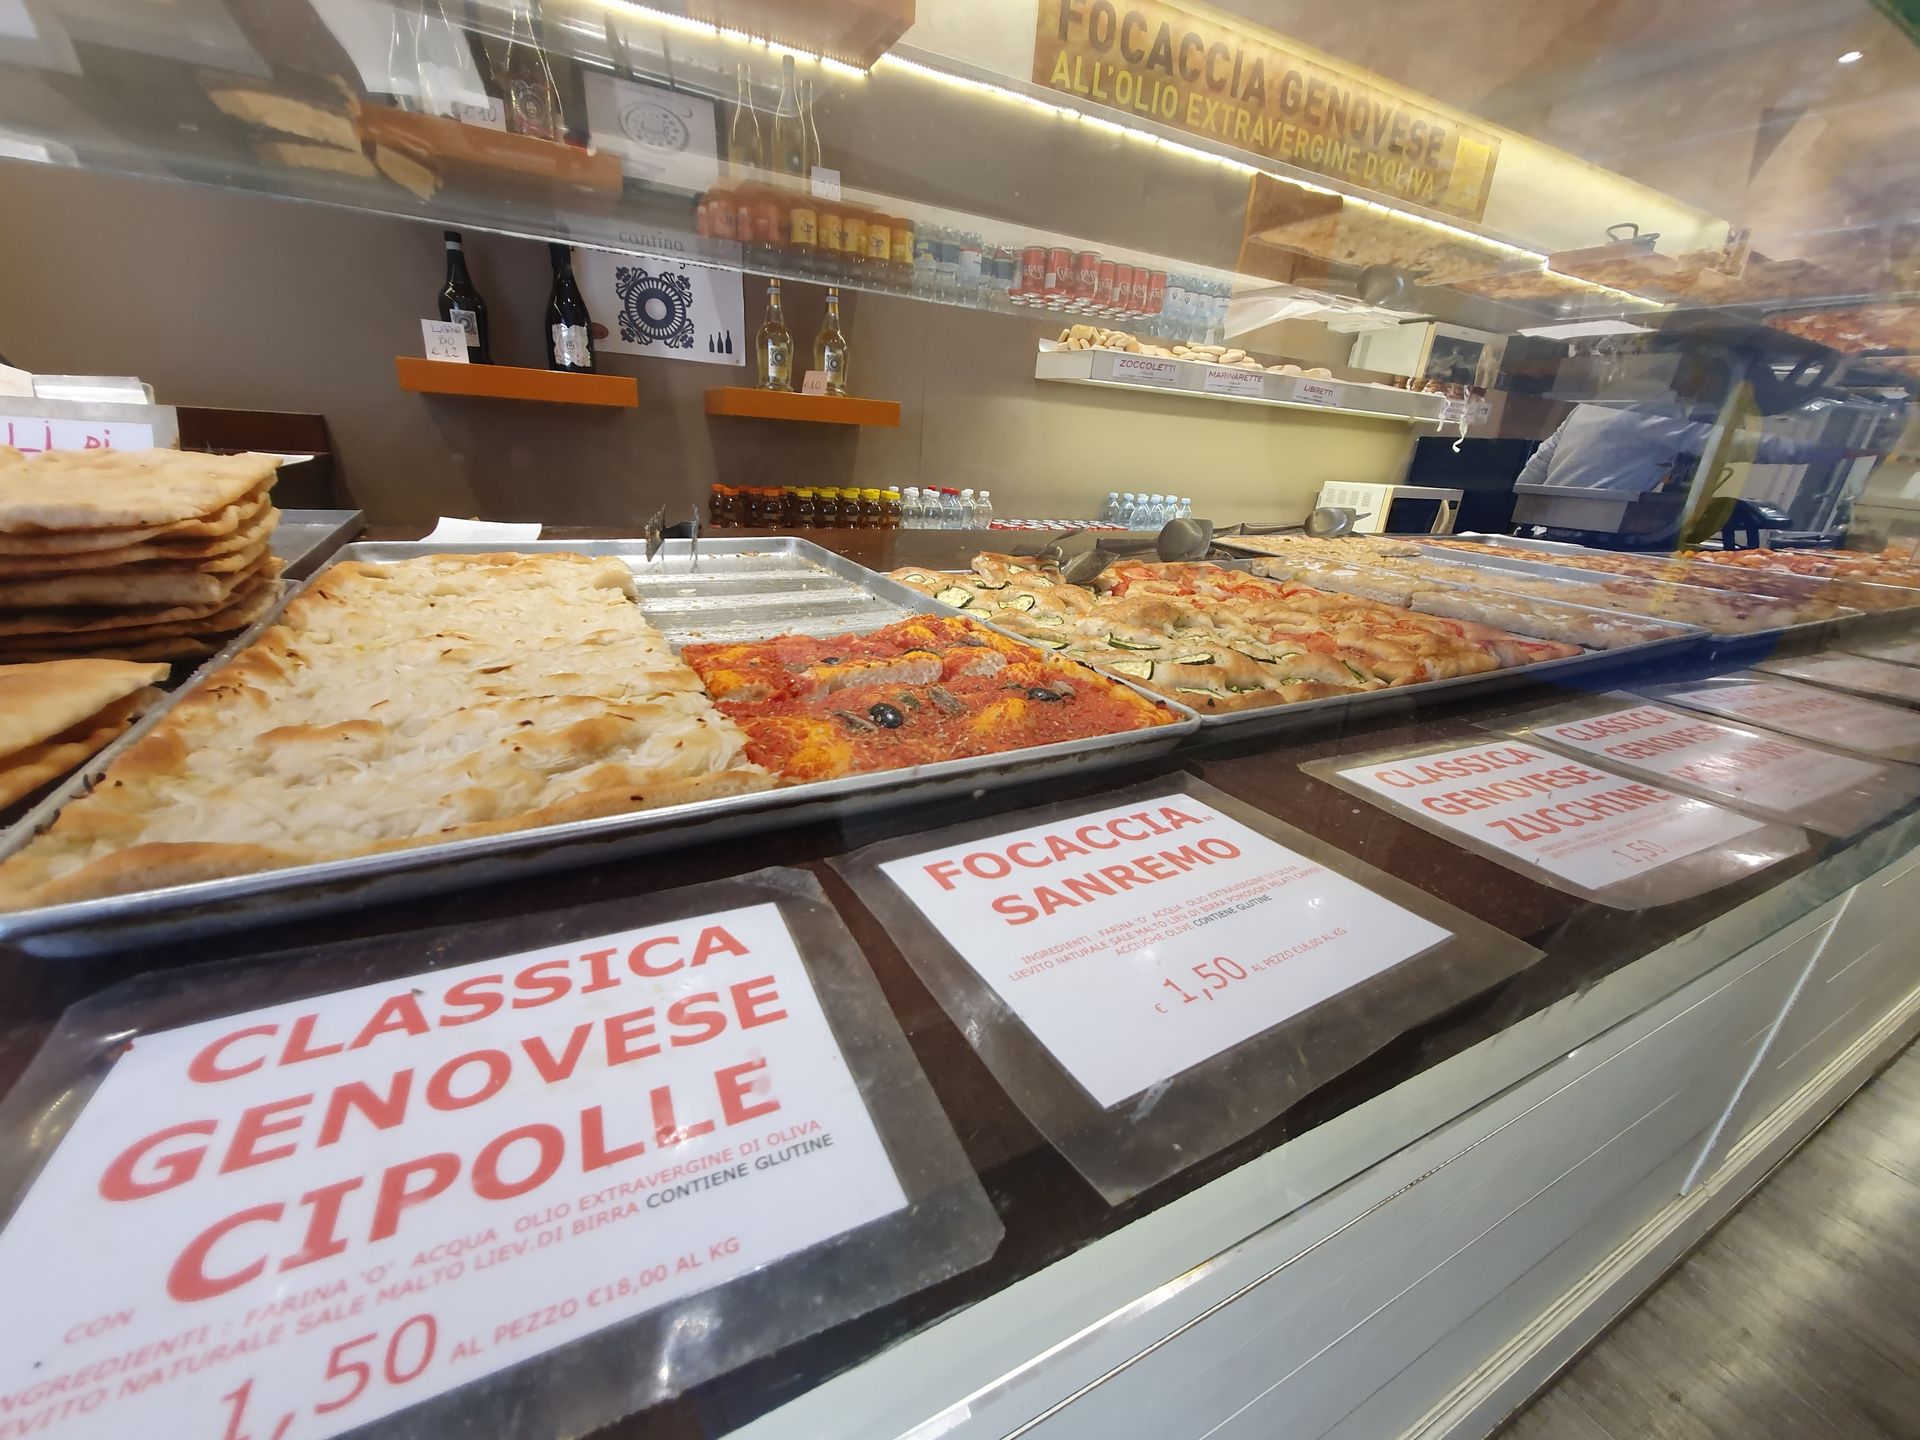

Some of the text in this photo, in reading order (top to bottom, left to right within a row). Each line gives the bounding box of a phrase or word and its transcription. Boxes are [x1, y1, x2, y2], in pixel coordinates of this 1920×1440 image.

[1050, 50, 1435, 198] ALL'OLIO EXTRAVERGINE D'OLIVA
[1058, 0, 1446, 167] FOCACCIA GENOVESE
[618, 231, 685, 252] cantina
[1119, 359, 1177, 372] ZOCCOLETTI
[1208, 371, 1263, 383] MARINARETTE
[1303, 384, 1334, 397] LIBRETTI
[1555, 710, 1677, 741] CLASSICA
[1603, 724, 1726, 760] GENOVESE
[1375, 747, 1543, 789] CLASSICA
[1421, 765, 1605, 817] GENOVESE
[923, 805, 1203, 891] FOCACCIA
[1485, 784, 1674, 842] ZUCCHINE
[1612, 839, 1669, 864] 1,50
[991, 837, 1241, 926] SANREMO
[1021, 935, 1092, 964] INGREDIENTI
[1098, 920, 1135, 937] FARINA
[1153, 904, 1183, 919] ACQUA
[1186, 895, 1208, 906] OLIO
[1208, 875, 1266, 899] EXTRAVERGINE
[1009, 960, 1054, 981] LIEVITO
[1055, 940, 1109, 965] NATURALE
[1109, 932, 1136, 946] SALE
[1135, 920, 1168, 937] MALTO
[1202, 900, 1228, 913] BIRRA
[1114, 894, 1273, 956] ACCIUGHE OLIVE CONTIENE GLUTINE
[187, 925, 750, 1084] CLASSICA
[1154, 1002, 1168, 1014] €
[1163, 956, 1248, 1004] 1,50
[1251, 962, 1264, 973] AL
[1263, 950, 1294, 967] PEZZO
[1321, 933, 1335, 943] AL
[1333, 927, 1348, 938] KG
[98, 975, 789, 1203] GENOVESE
[165, 1057, 782, 1303] CIPOLLE
[0, 1324, 209, 1413] NGREDIENTI
[243, 1279, 349, 1328] FARINA
[411, 1227, 498, 1269] ACQUA
[514, 1202, 571, 1234] OLIO
[578, 1150, 734, 1213] EXTRAVERGINE
[740, 1138, 761, 1158] DI
[766, 1119, 822, 1147] OLIVA
[117, 1321, 286, 1400] NATURALE
[294, 1295, 366, 1335] SALE
[376, 1261, 466, 1305] MALTO
[571, 1201, 640, 1236] BIRRA
[645, 1161, 750, 1210] CONTIENE
[754, 1132, 835, 1171] GLUTINE
[63, 1308, 136, 1345] CON
[219, 1236, 741, 1440] 1,50 AL PEZZO €18,00 AL KG
